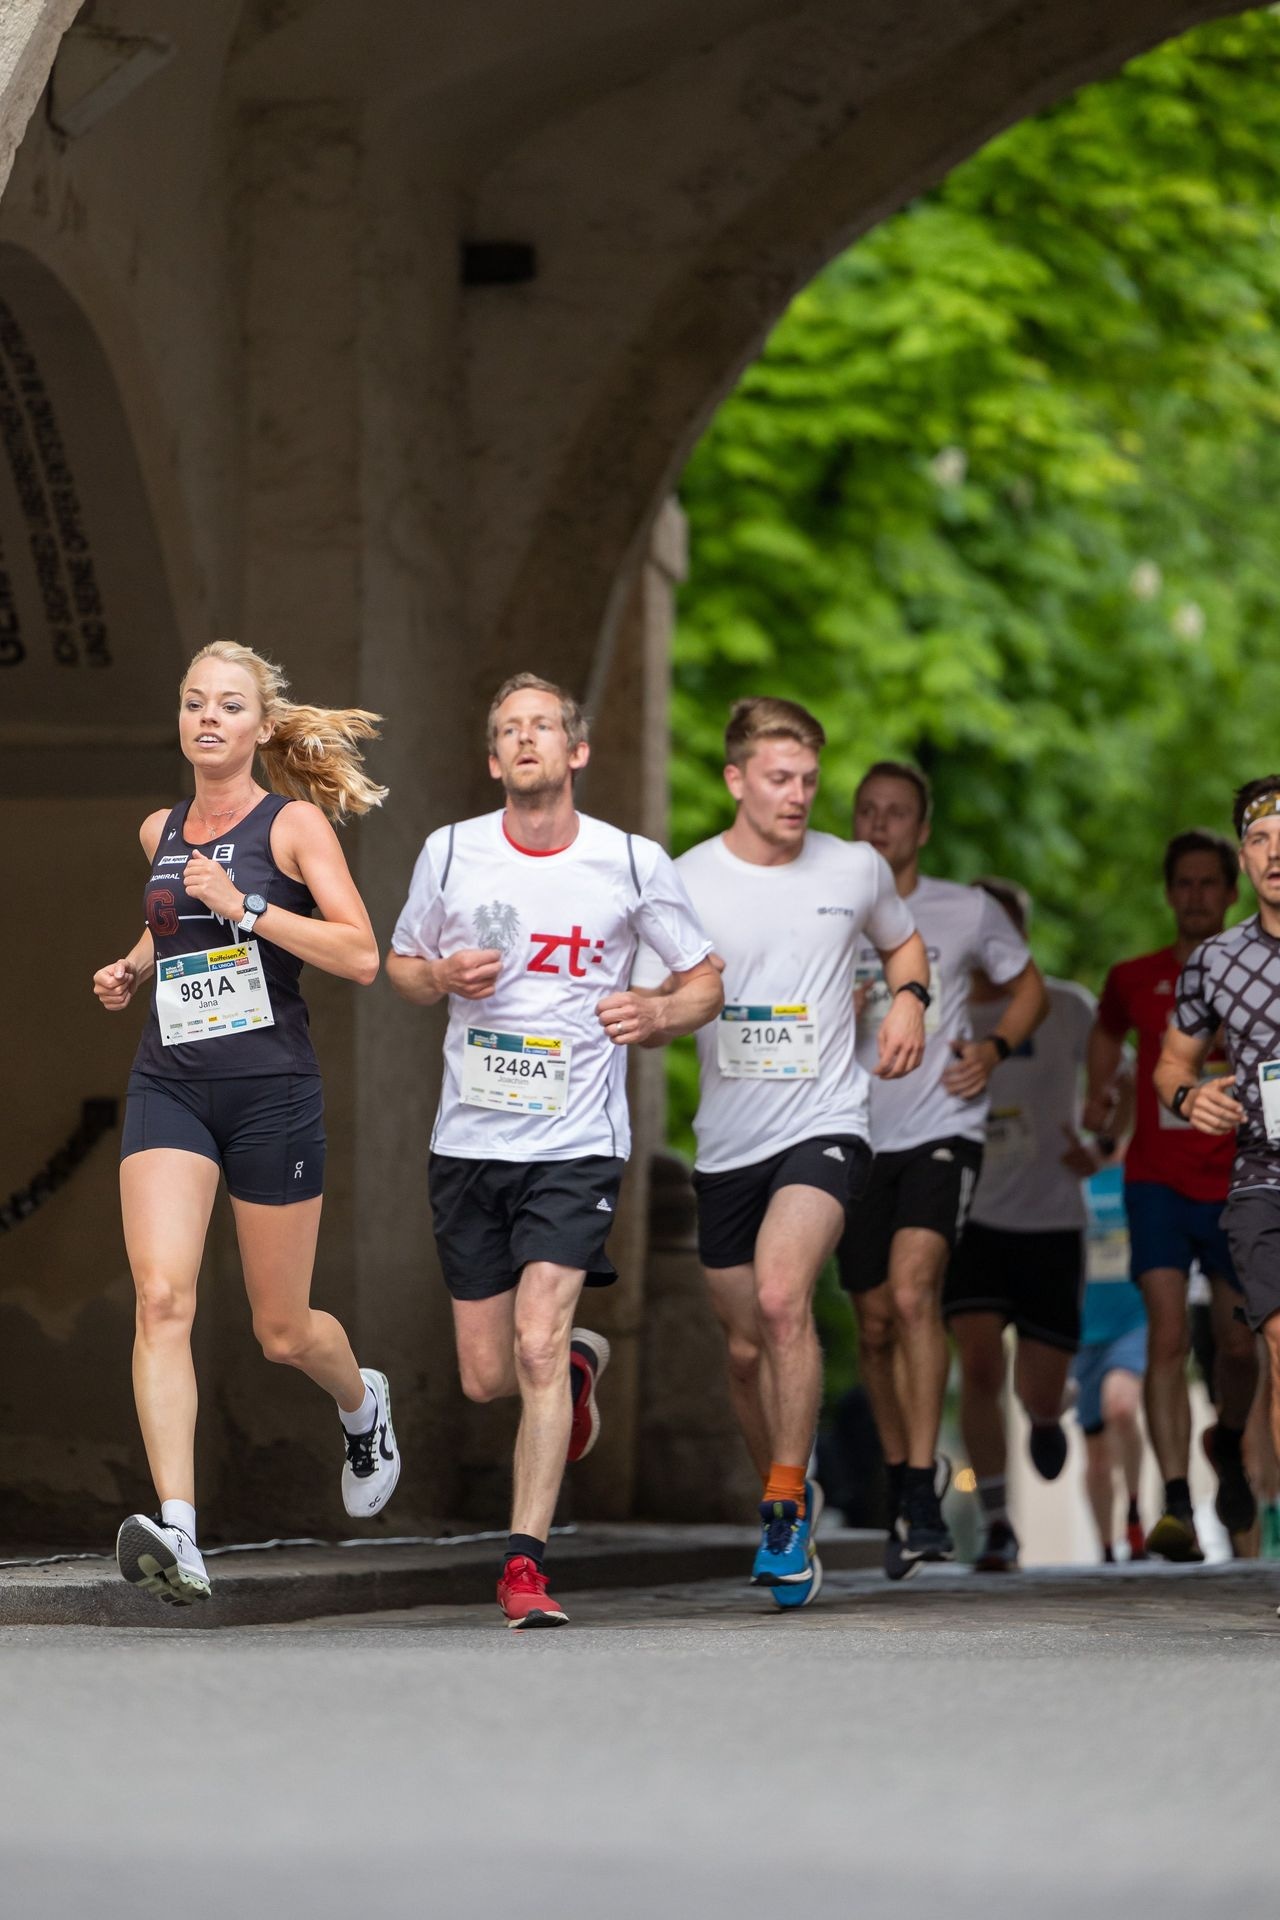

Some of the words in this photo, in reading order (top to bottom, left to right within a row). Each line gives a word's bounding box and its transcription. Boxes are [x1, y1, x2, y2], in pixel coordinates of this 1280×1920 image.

[209, 954, 238, 963] Raiffeisen
[180, 975, 236, 1003] 981A
[198, 999, 218, 1009] Jana
[741, 1027, 792, 1044] 210A
[483, 1054, 547, 1079] 1248A
